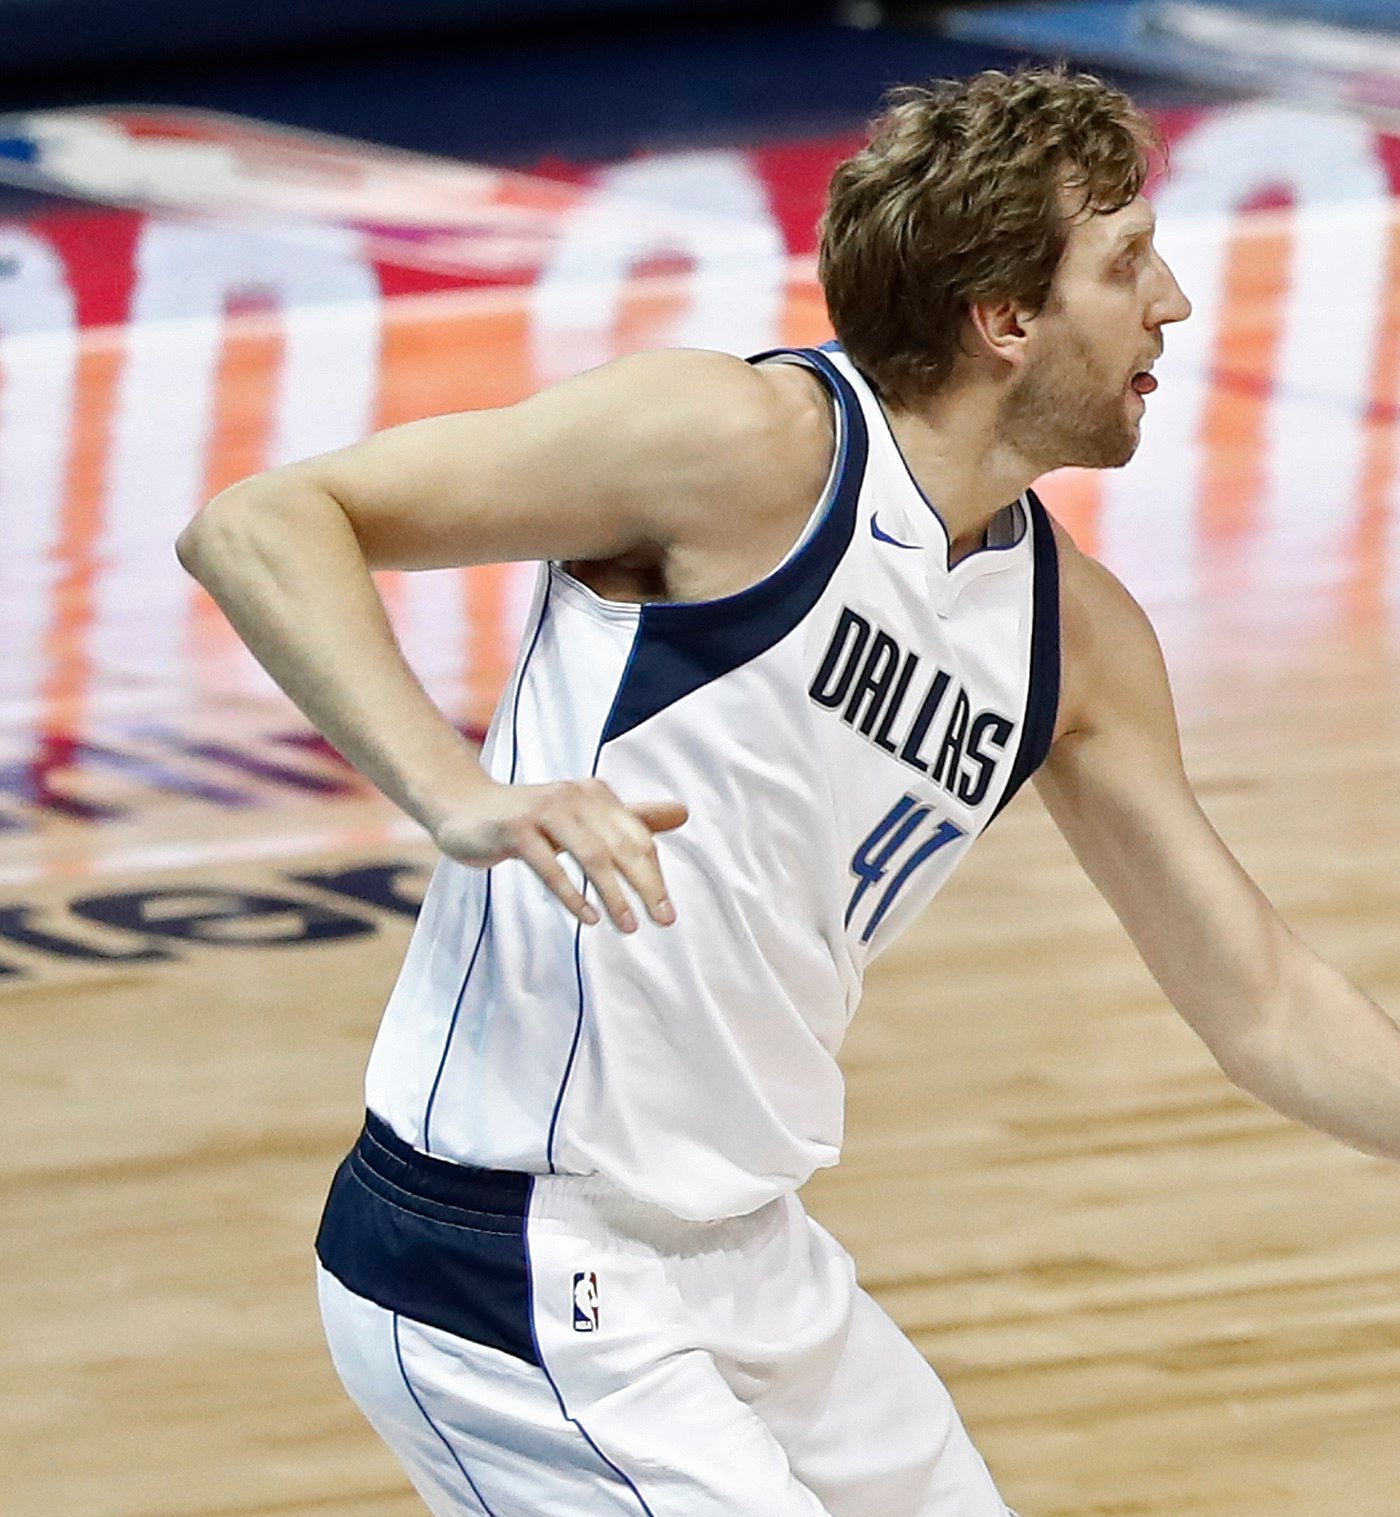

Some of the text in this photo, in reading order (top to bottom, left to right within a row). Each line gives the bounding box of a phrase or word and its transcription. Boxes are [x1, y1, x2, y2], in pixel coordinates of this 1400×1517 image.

[808, 604, 1016, 807] DALLAS
[0, 862, 428, 976] ter
[844, 793, 966, 943] 41
